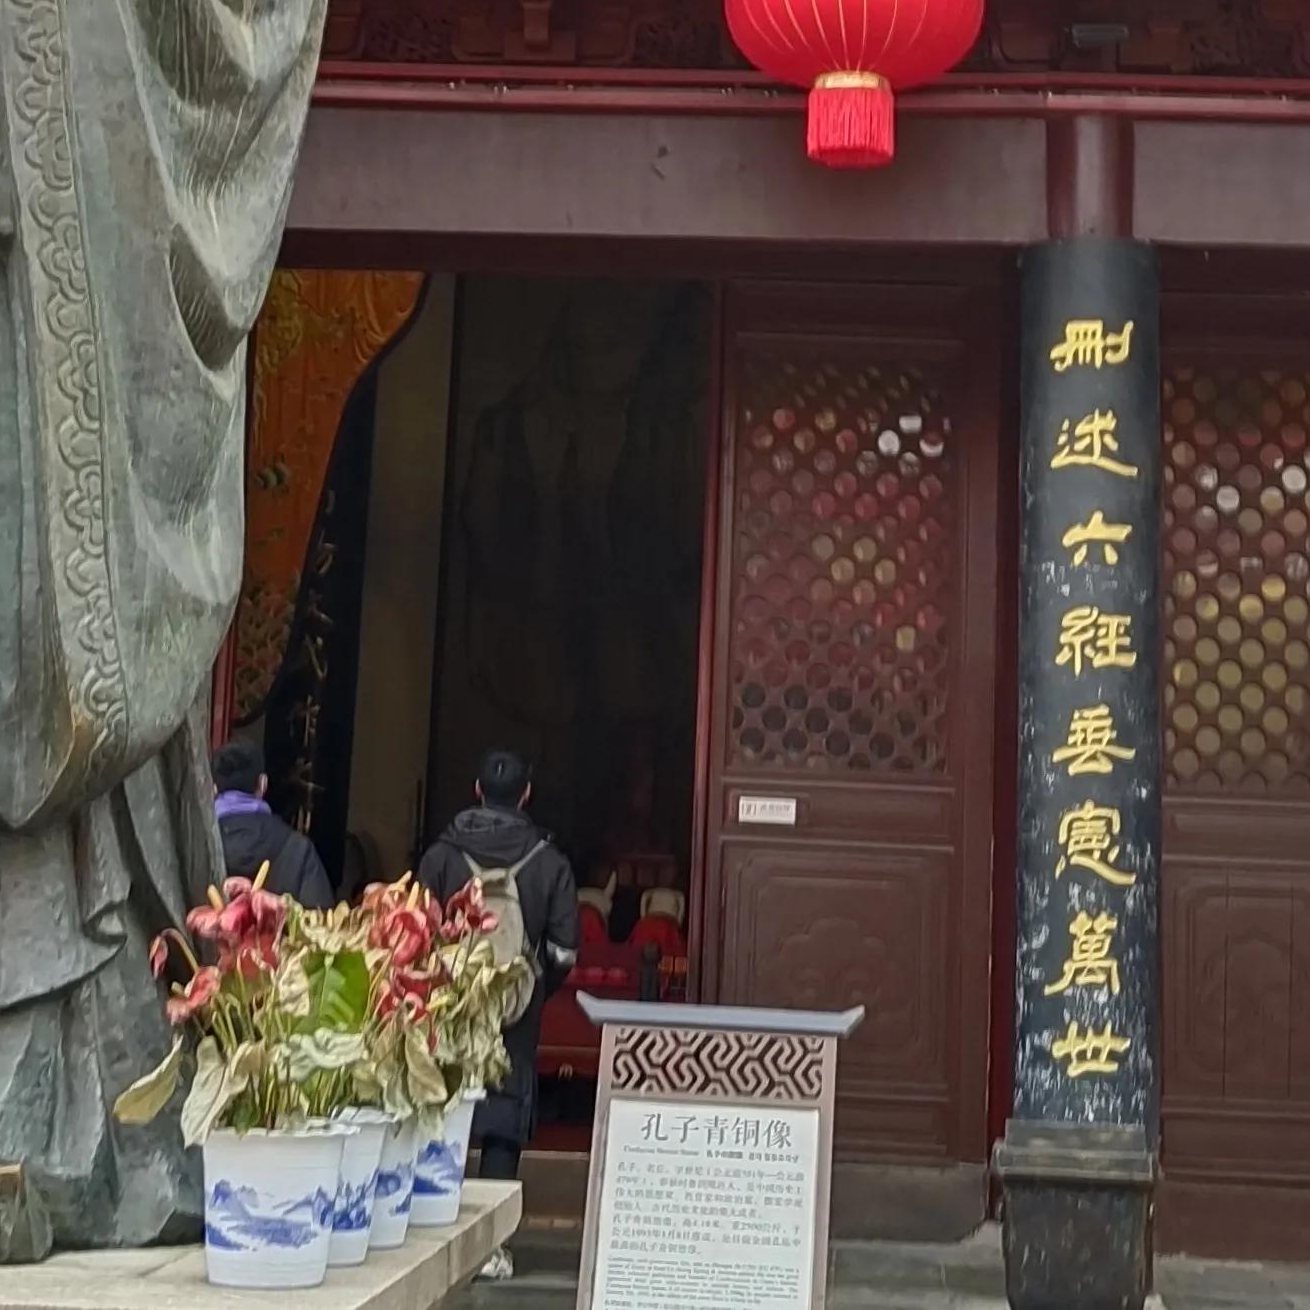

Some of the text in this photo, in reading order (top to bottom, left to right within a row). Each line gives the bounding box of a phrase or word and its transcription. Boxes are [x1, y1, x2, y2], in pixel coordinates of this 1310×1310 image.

[640, 1112, 792, 1150] 孔子青铜像
